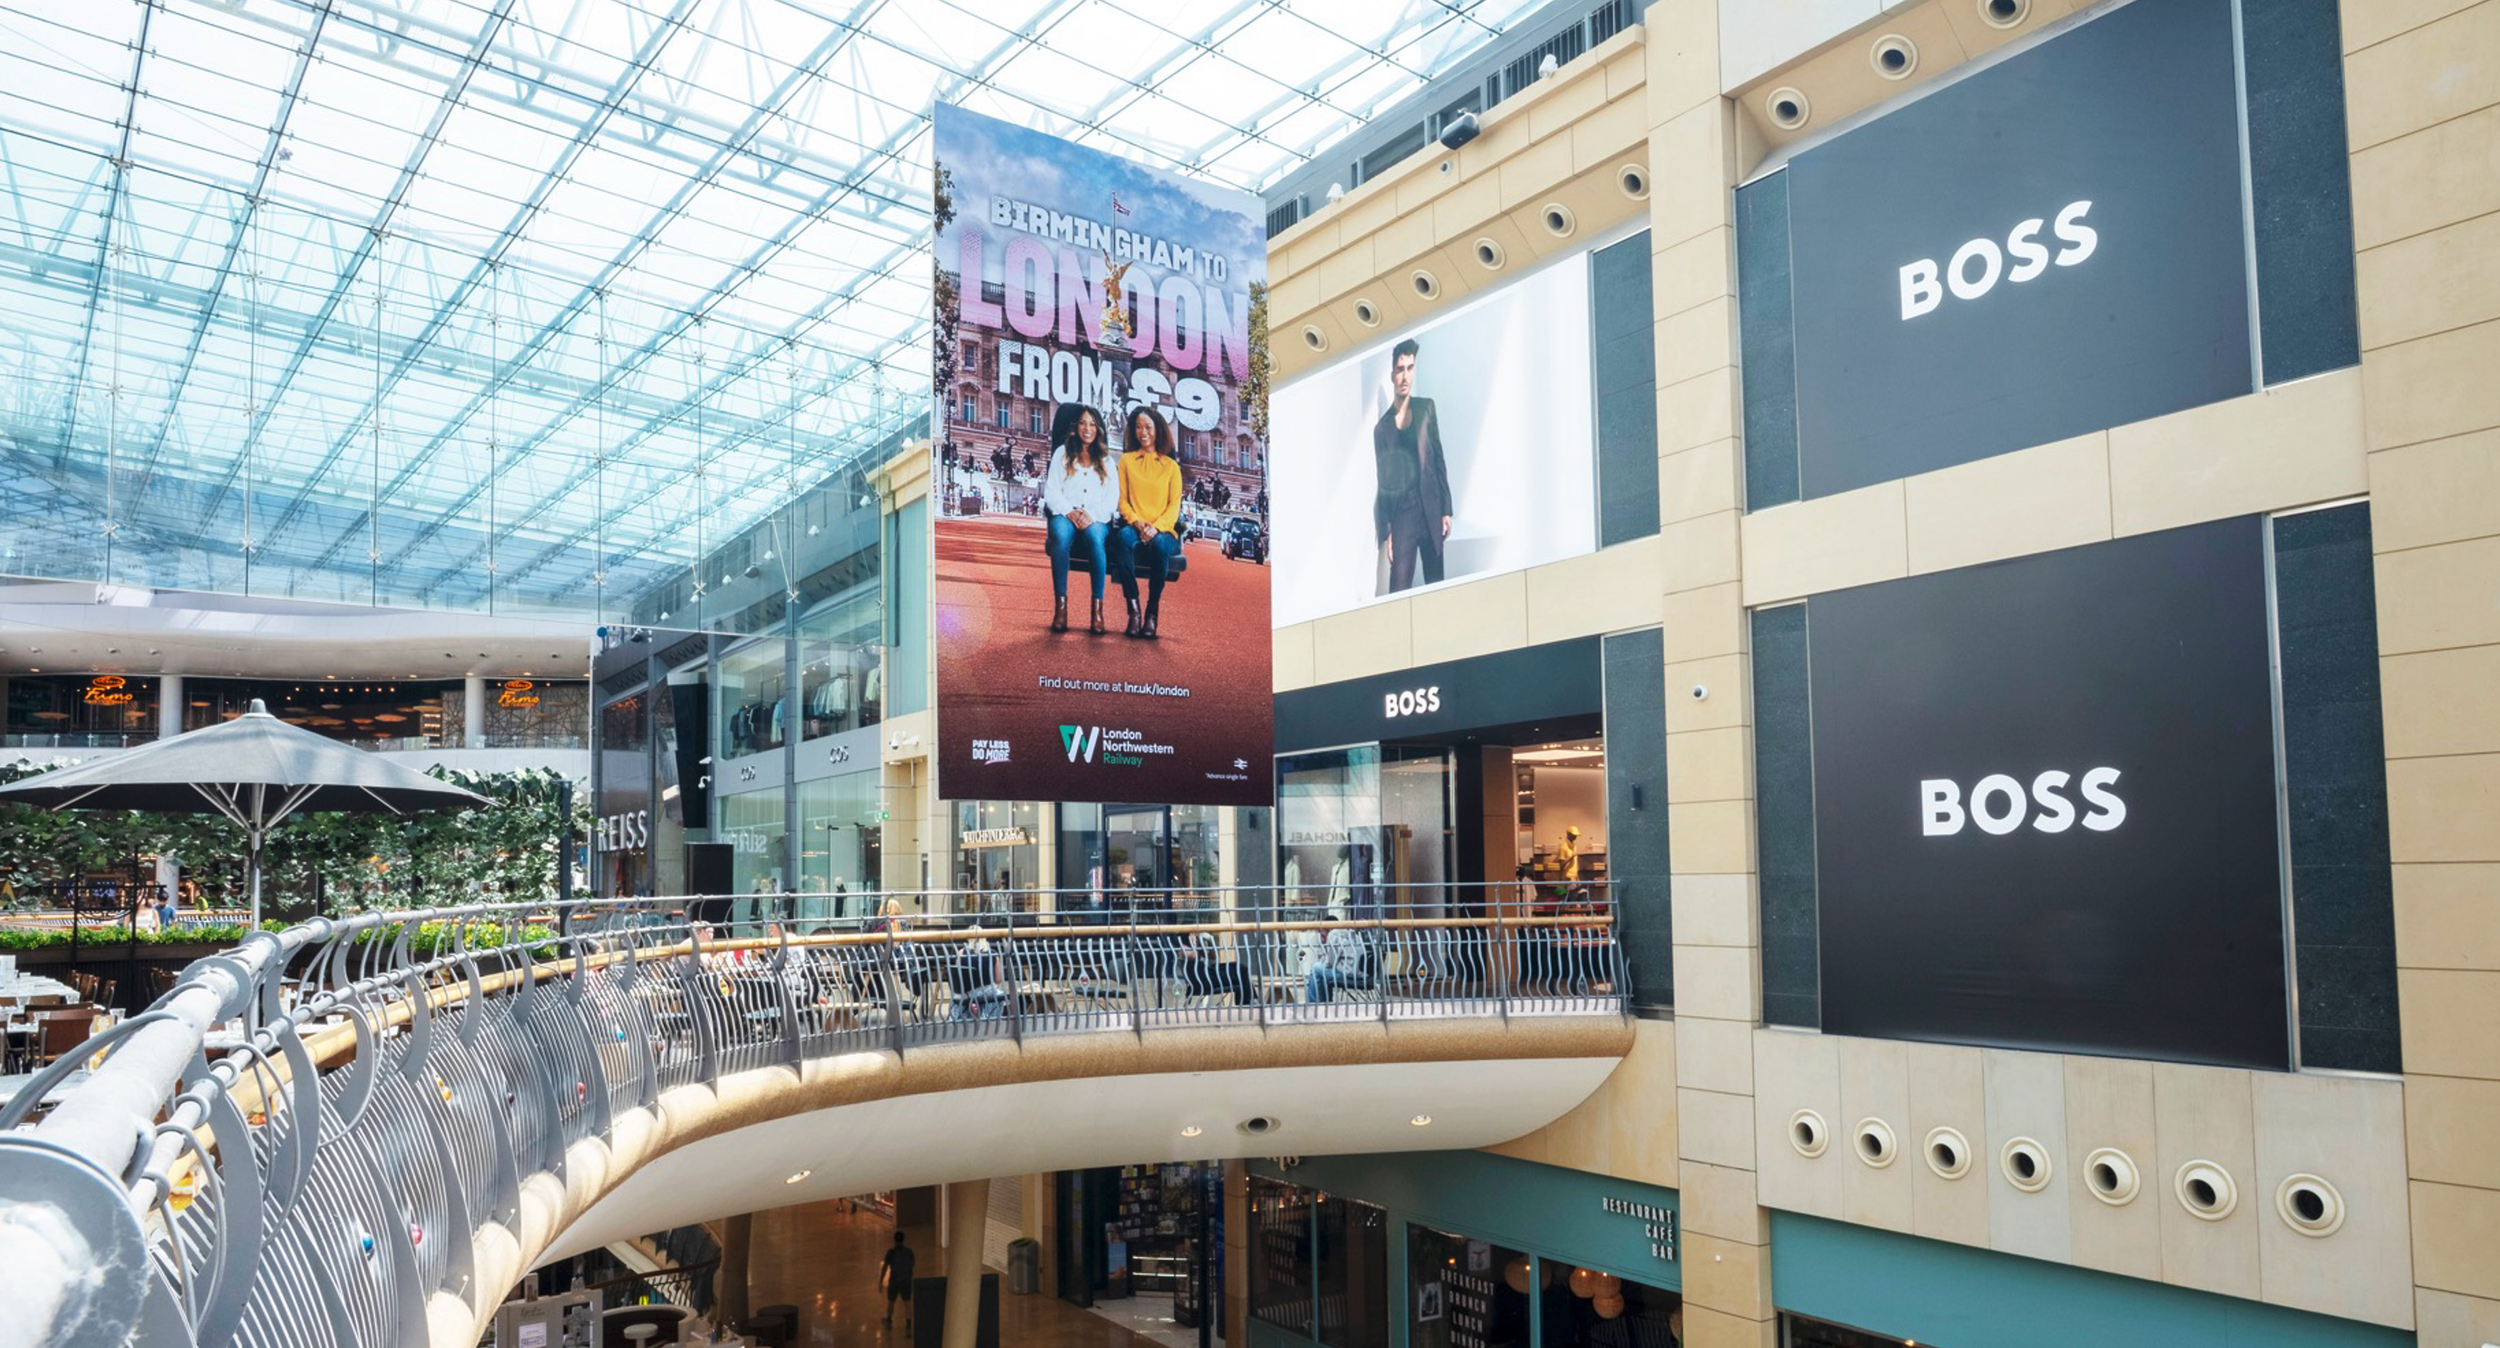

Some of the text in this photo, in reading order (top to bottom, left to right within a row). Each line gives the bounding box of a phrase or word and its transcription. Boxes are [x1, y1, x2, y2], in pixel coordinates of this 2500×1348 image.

[991, 196, 1227, 282] BIRMINGHAM TO
[1899, 200, 2098, 321] BOSS
[959, 223, 1249, 381] LONDON
[998, 339, 1113, 412] FROM
[84, 687, 133, 701] Fumo
[497, 691, 540, 704] Fumo
[1039, 676, 1190, 697] Find out more at lnr.uk/london
[1385, 686, 1440, 719] BOSS
[972, 739, 988, 749] PAY
[1103, 727, 1142, 740] London
[830, 745, 850, 764] COS
[972, 748, 1011, 761] DO MORE
[1103, 740, 1174, 754] Northwestern
[1103, 752, 1144, 768] Railway
[1921, 767, 2127, 836] BOSS
[598, 810, 648, 851] REISS
[1602, 1196, 1672, 1224] RESTAURANT
[1645, 1223, 1673, 1243] CAFÉ
[1652, 1243, 1674, 1261] BAR
[1440, 1267, 1495, 1296] BREAKFAST
[1448, 1290, 1487, 1314] BRUNCH
[1452, 1310, 1483, 1333] LUNCH
